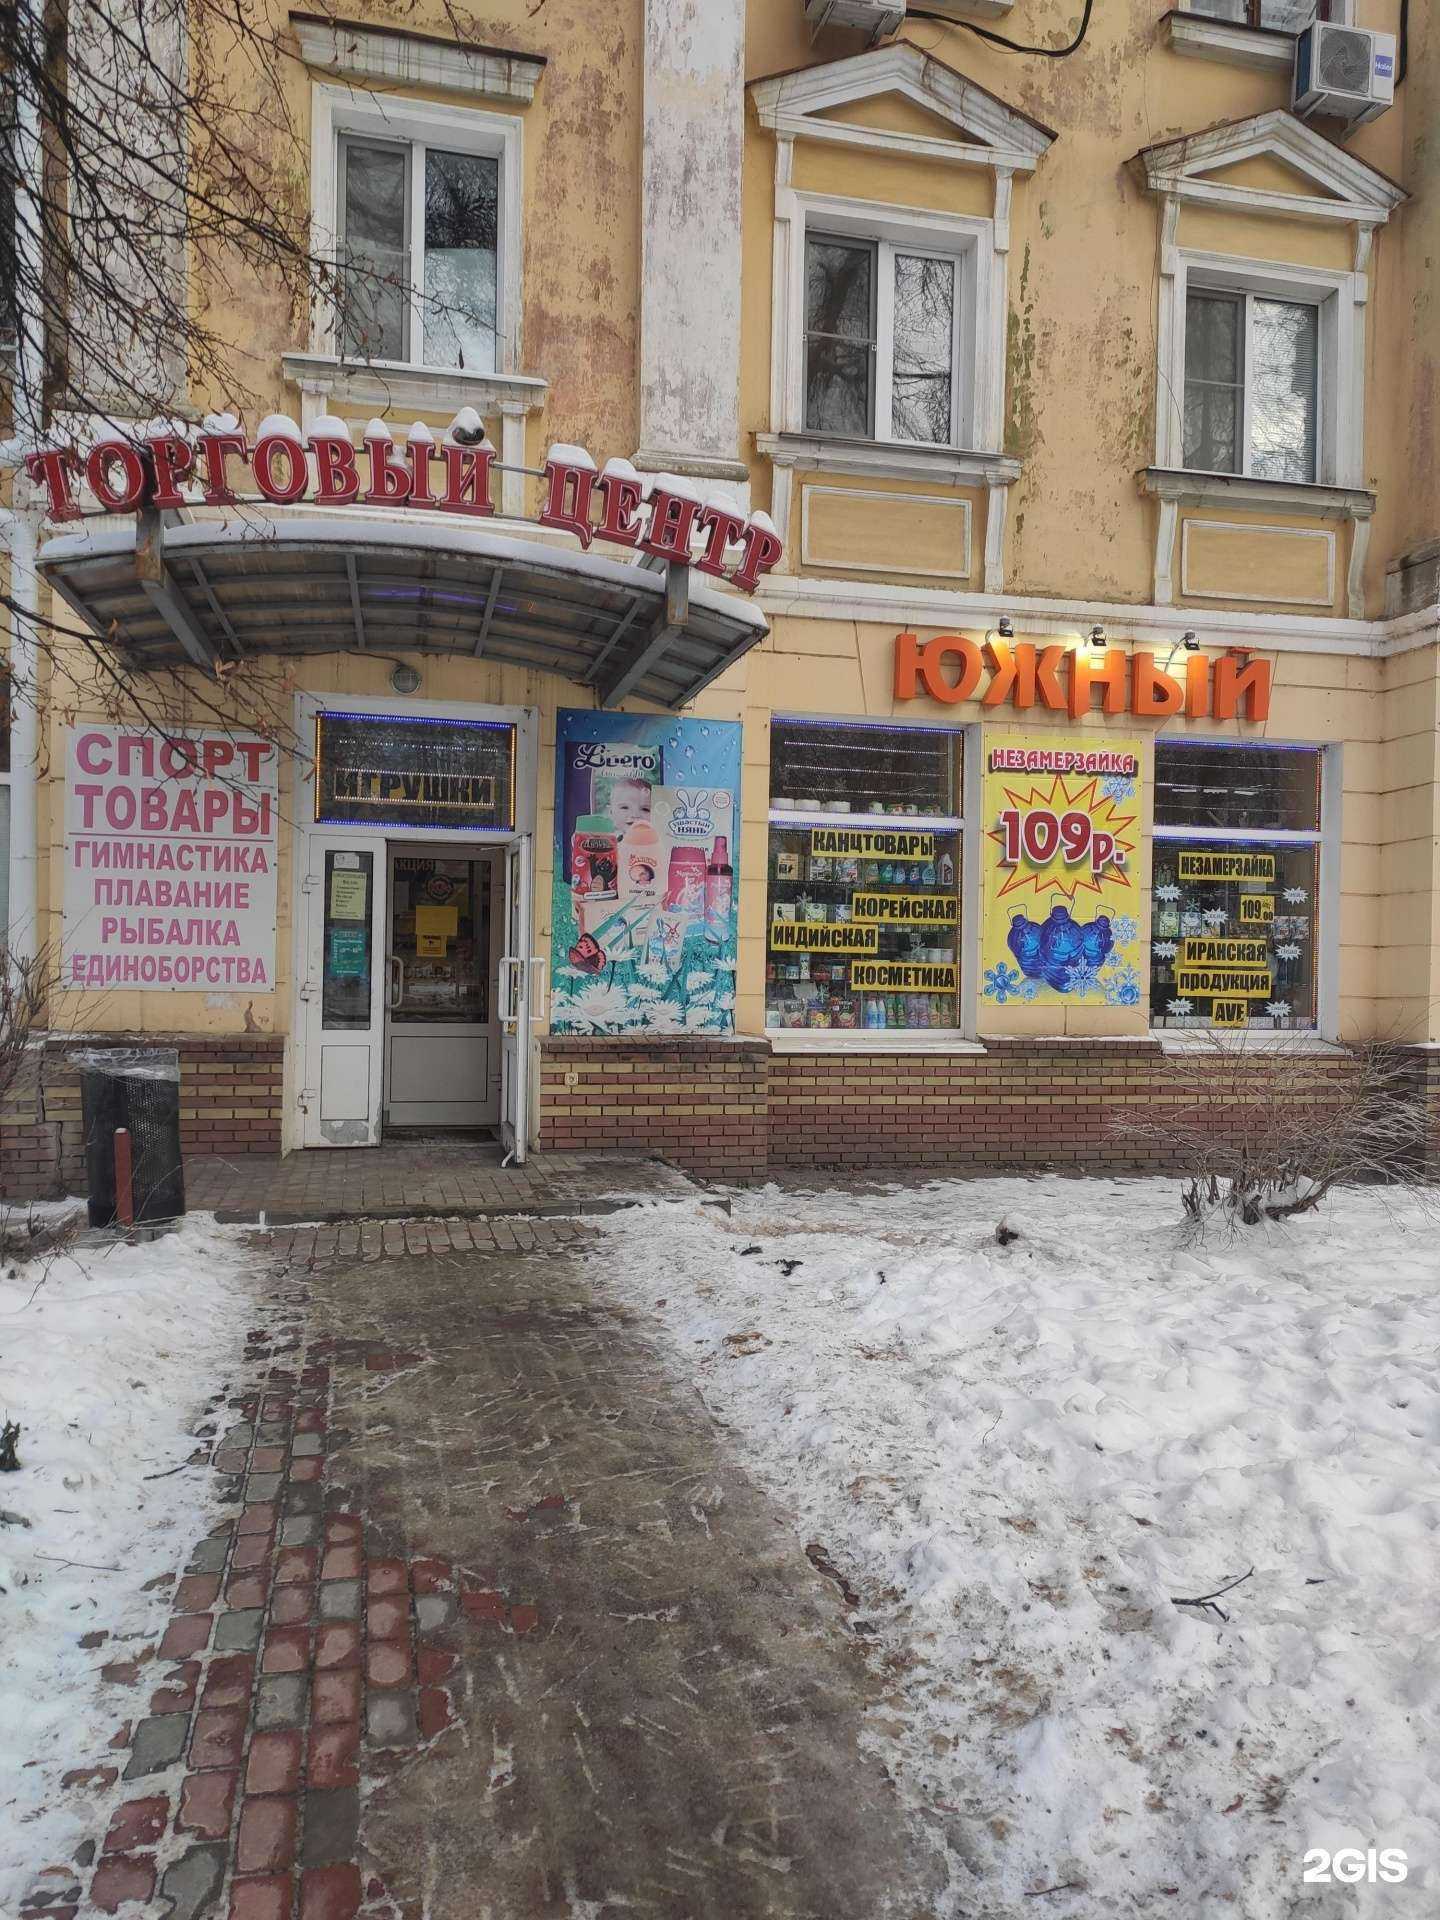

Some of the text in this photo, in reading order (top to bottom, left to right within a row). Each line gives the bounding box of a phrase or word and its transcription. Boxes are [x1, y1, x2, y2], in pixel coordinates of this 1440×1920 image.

[1376, 61, 1392, 71] Haier
[26, 428, 783, 594] ТОРГОВЫЙ ЦЕНТР
[895, 633, 1271, 721] ЮЖНЫЙ
[75, 733, 273, 783] СПОРТ
[991, 748, 1135, 773] НЕЗАМЕРЗАЙКА
[74, 784, 272, 836] ТОВАРЫ
[813, 830, 934, 857] КАНЦТОВАРЫ
[1001, 809, 1126, 872] 109р.
[73, 840, 270, 874] ГИМНАСТИКА
[1181, 854, 1274, 878] НЕЗАМЕРЗАЙКА
[94, 878, 250, 910] ПЛАВАНИЕ
[854, 896, 957, 920] КОРЕЙСКАЯ
[101, 916, 241, 947] РЫБАЛКА
[773, 924, 877, 949] ИНДИЙСКАЯ
[71, 954, 267, 987] ЕДИНОБОРСТВА
[853, 964, 956, 988] КОСМЕТИКА
[1215, 1002, 1246, 1022] AVE
